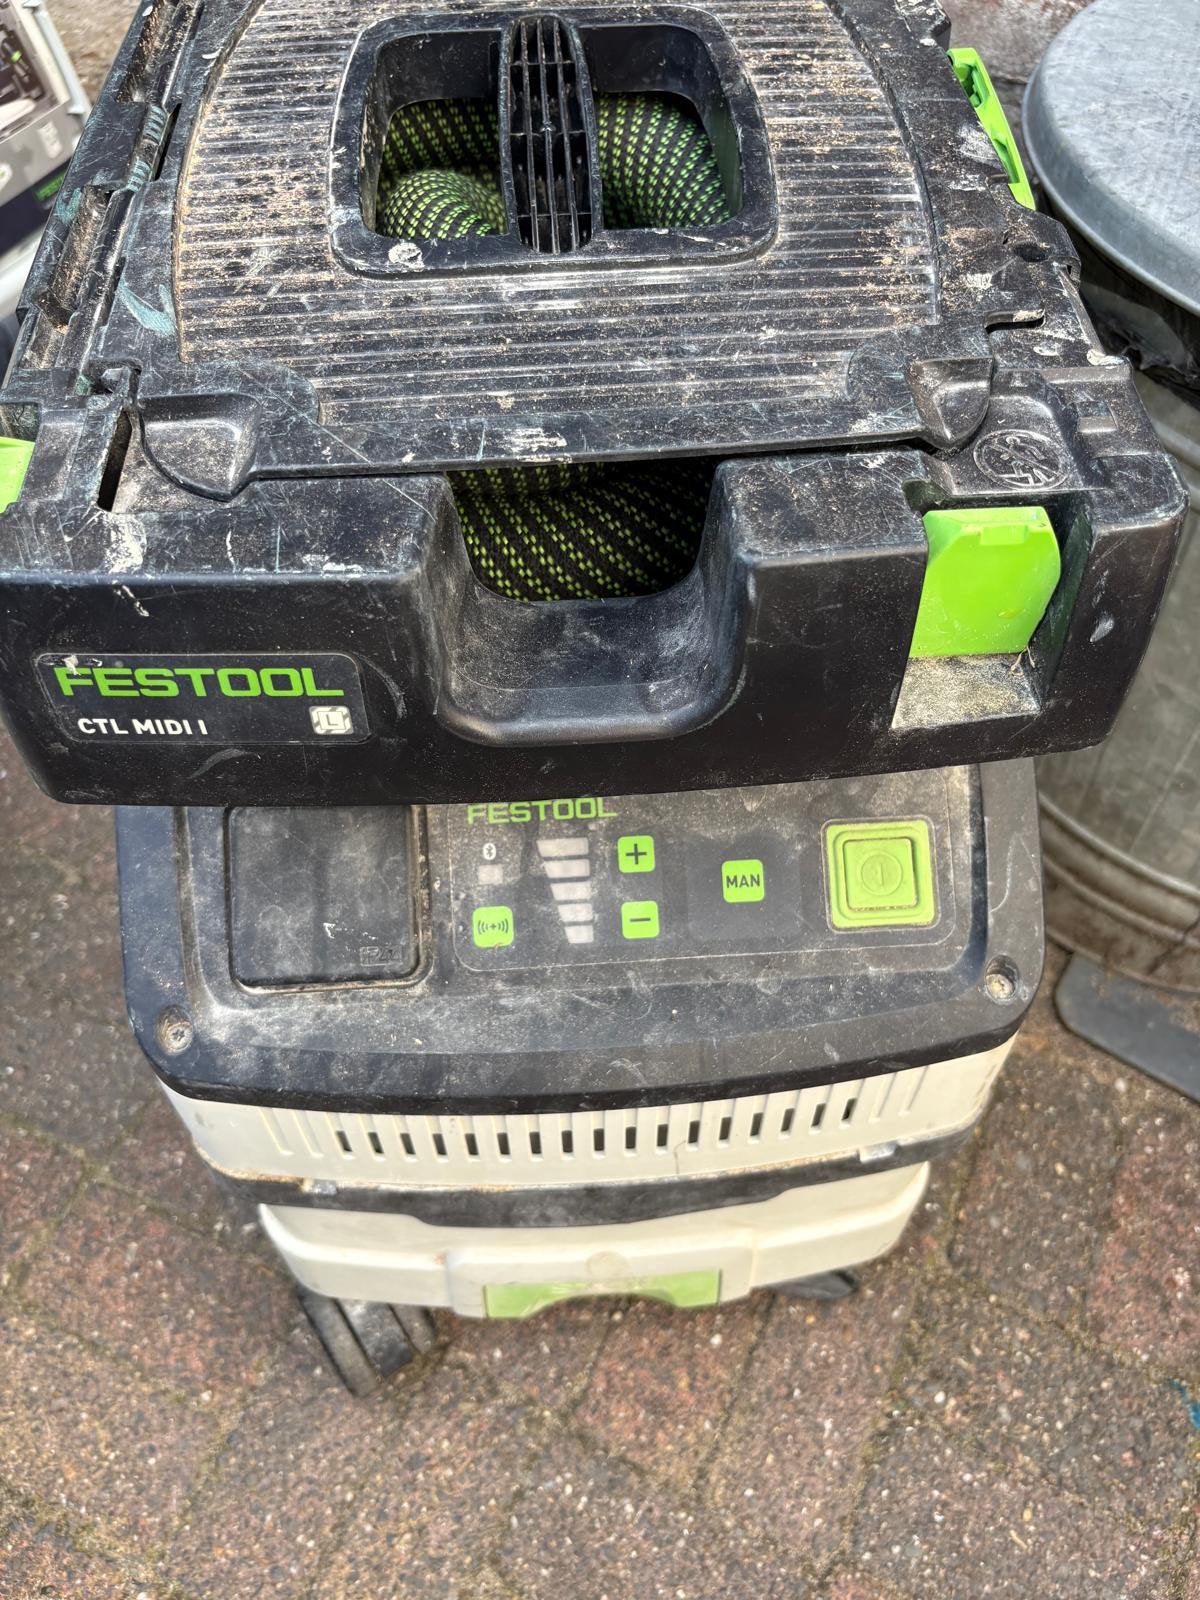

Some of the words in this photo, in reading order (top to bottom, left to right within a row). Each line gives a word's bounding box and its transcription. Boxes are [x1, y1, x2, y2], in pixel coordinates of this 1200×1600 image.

[54, 667, 344, 697] FESTOOL
[78, 717, 129, 734] CTL
[132, 719, 193, 735] MIDI
[467, 798, 618, 825] FESTOOL
[726, 874, 761, 888] MAN
